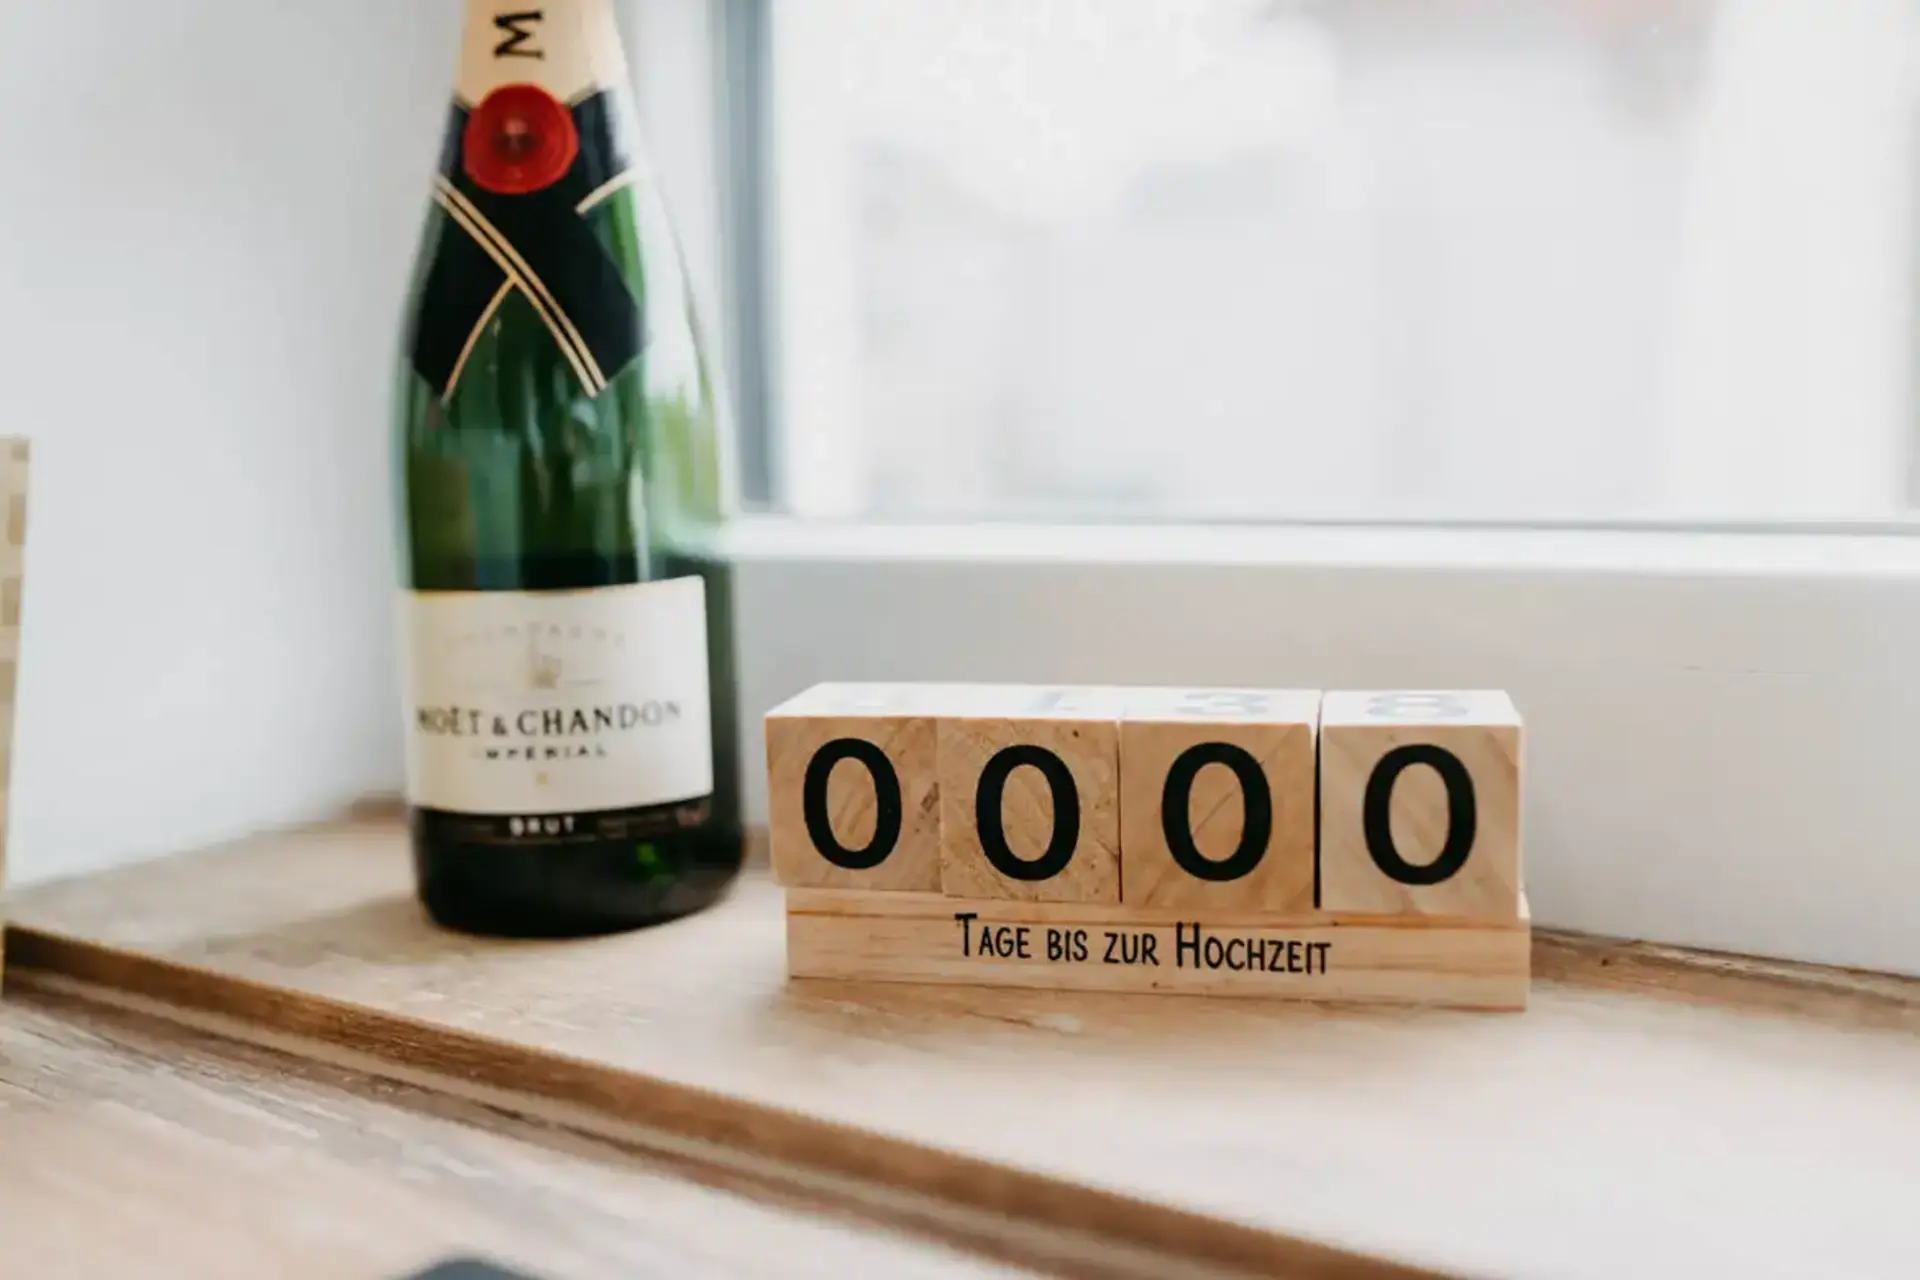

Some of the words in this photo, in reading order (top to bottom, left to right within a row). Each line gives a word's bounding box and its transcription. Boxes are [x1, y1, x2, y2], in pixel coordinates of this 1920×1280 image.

[493, 11, 544, 60] M
[492, 715, 509, 737] &
[516, 701, 681, 737] CHANDON
[803, 737, 902, 869] 0
[975, 744, 1080, 881] 0
[1161, 742, 1272, 882] 0
[1363, 744, 1477, 886] 0
[1047, 926, 1088, 962] BIS
[1103, 931, 1159, 966] ZUR
